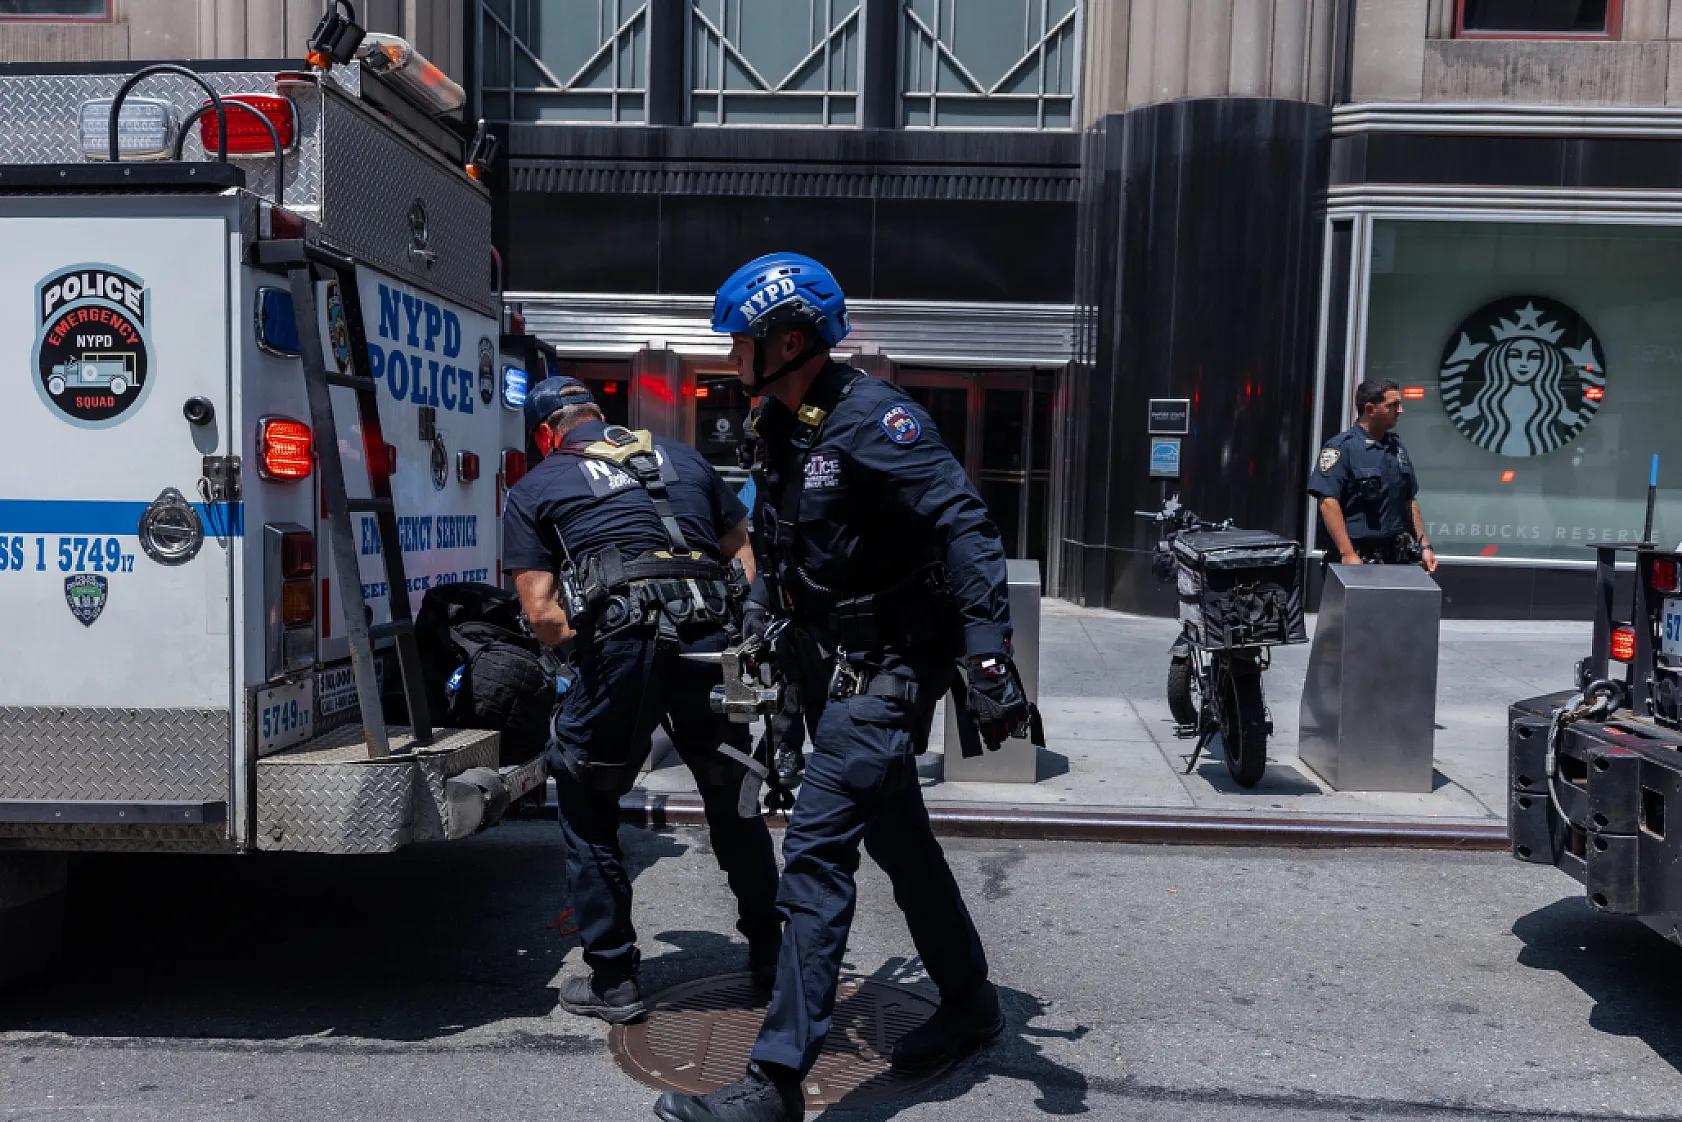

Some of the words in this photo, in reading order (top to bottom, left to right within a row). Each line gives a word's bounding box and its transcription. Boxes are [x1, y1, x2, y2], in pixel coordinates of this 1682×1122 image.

[45, 273, 145, 316] POLICE
[739, 277, 796, 321] NYPD
[48, 308, 139, 346] EMERGENCY
[378, 283, 461, 358] NYPD
[76, 334, 112, 348] NYPD
[367, 341, 474, 415] POLICE
[75, 396, 116, 409] SQUAD
[436, 514, 477, 549] SERVICE
[1425, 521, 1541, 539] TARBUCKS
[1556, 526, 1661, 544] RESERVE
[35, 537, 46, 572] 1
[362, 582, 387, 599] EEP
[406, 576, 430, 592] ACK
[463, 569, 487, 582] FEET
[263, 700, 298, 739] 5749
